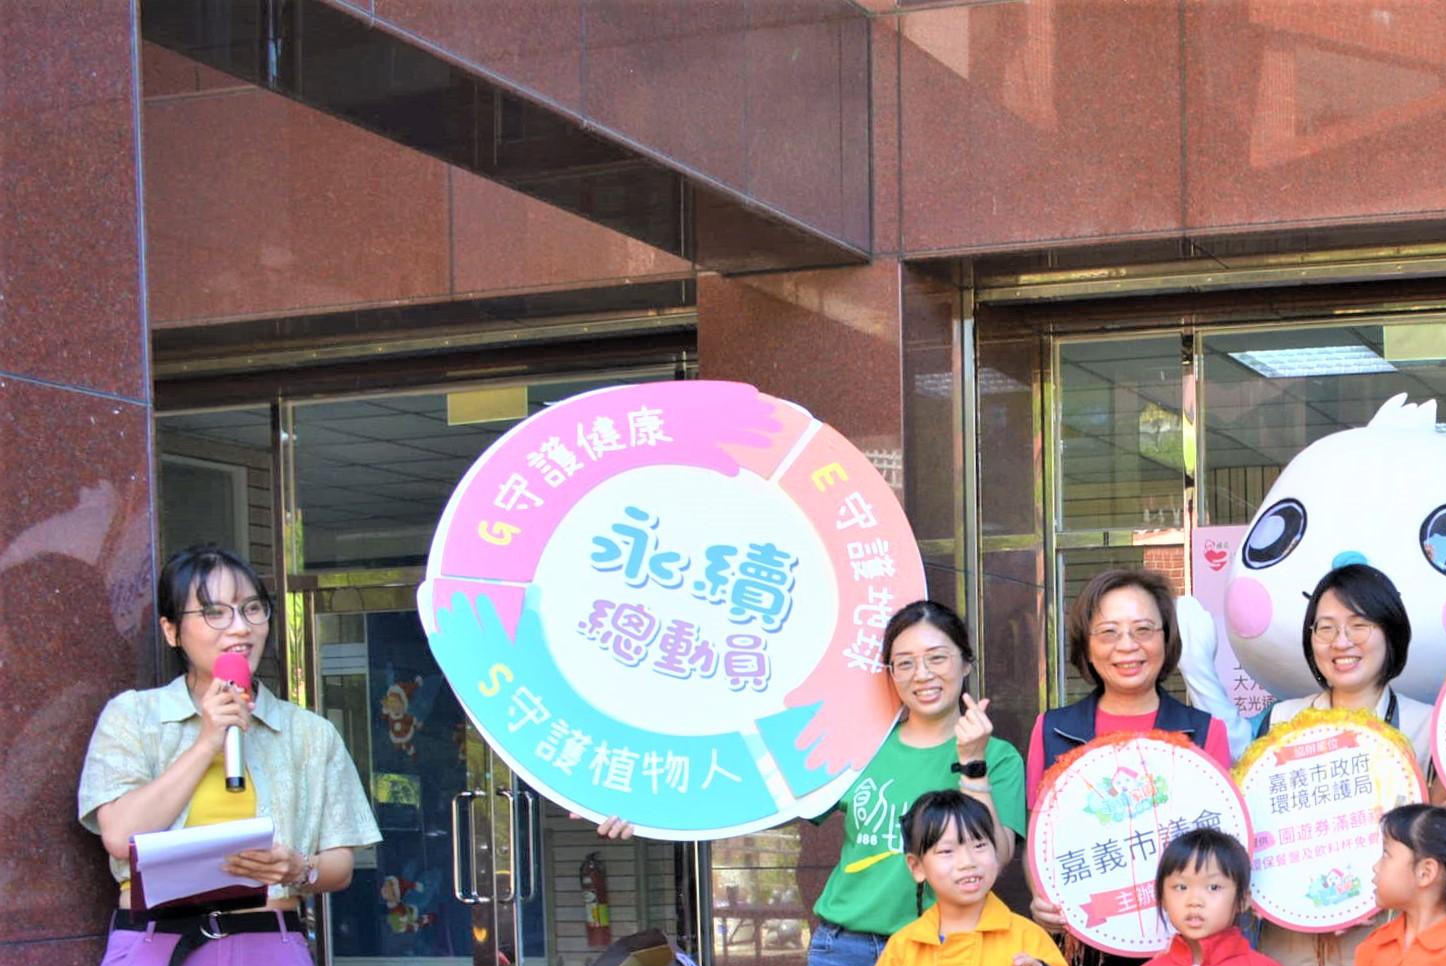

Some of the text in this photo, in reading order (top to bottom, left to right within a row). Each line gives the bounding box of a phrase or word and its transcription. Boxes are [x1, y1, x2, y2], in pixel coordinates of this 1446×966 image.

[477, 406, 673, 546] G守護健康
[590, 506, 798, 634] 永續
[810, 461, 896, 674] E守護地球
[577, 598, 771, 691] 總動員
[477, 663, 742, 794] S守護植物人
[1269, 753, 1370, 795] 嘉義市政府
[1270, 775, 1373, 814] 環境保護局
